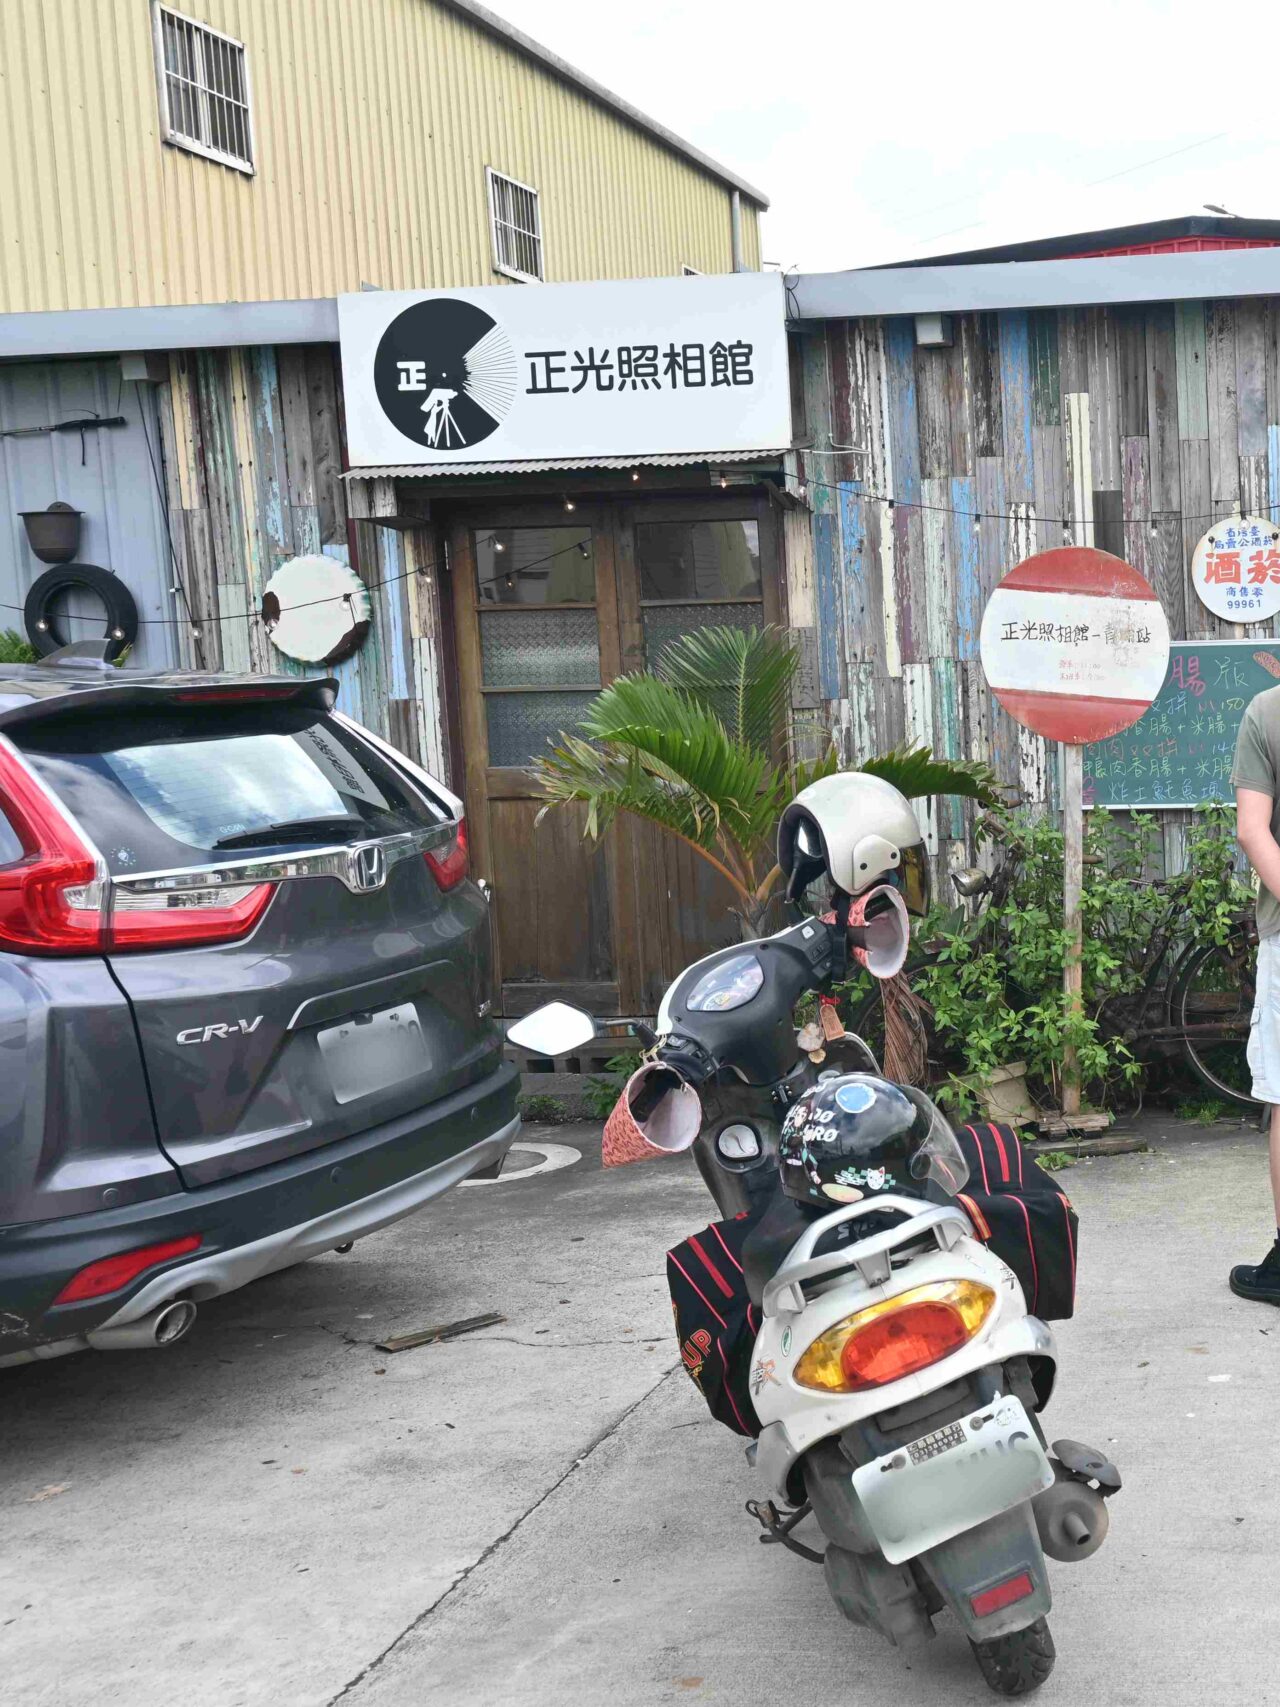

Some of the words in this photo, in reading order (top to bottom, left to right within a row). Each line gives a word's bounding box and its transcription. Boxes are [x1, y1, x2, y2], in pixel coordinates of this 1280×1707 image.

[396, 361, 427, 391] 正
[524, 340, 754, 394] 正光照相館
[1227, 600, 1261, 609] 99961
[176, 1015, 264, 1045] CR-V
